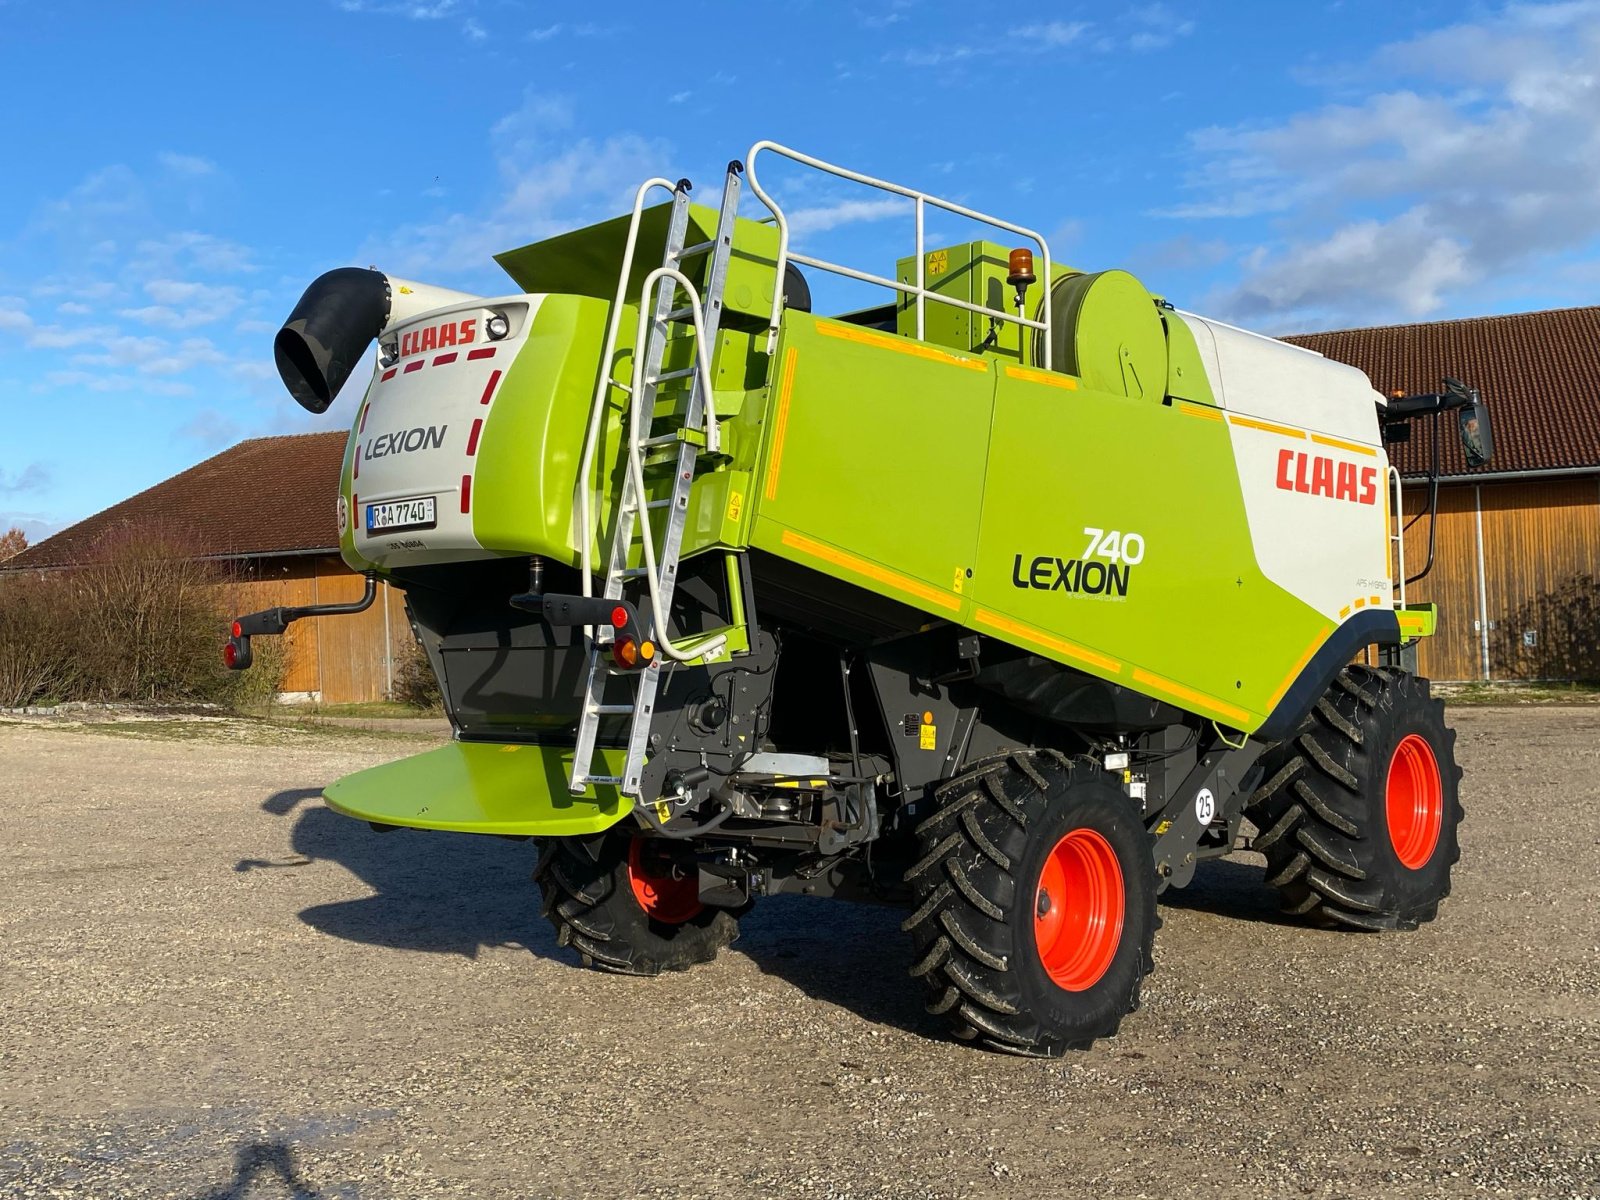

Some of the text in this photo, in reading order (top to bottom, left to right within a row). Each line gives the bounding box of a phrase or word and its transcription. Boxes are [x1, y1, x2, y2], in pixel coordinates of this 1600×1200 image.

[402, 319, 476, 357] CLAAS
[365, 425, 448, 460] LEXION
[1276, 449, 1377, 505] CLAAS
[374, 502, 425, 526] R A 7740
[1082, 527, 1145, 565] 740
[1012, 554, 1130, 596] LEXION
[1199, 795, 1211, 819] 25
